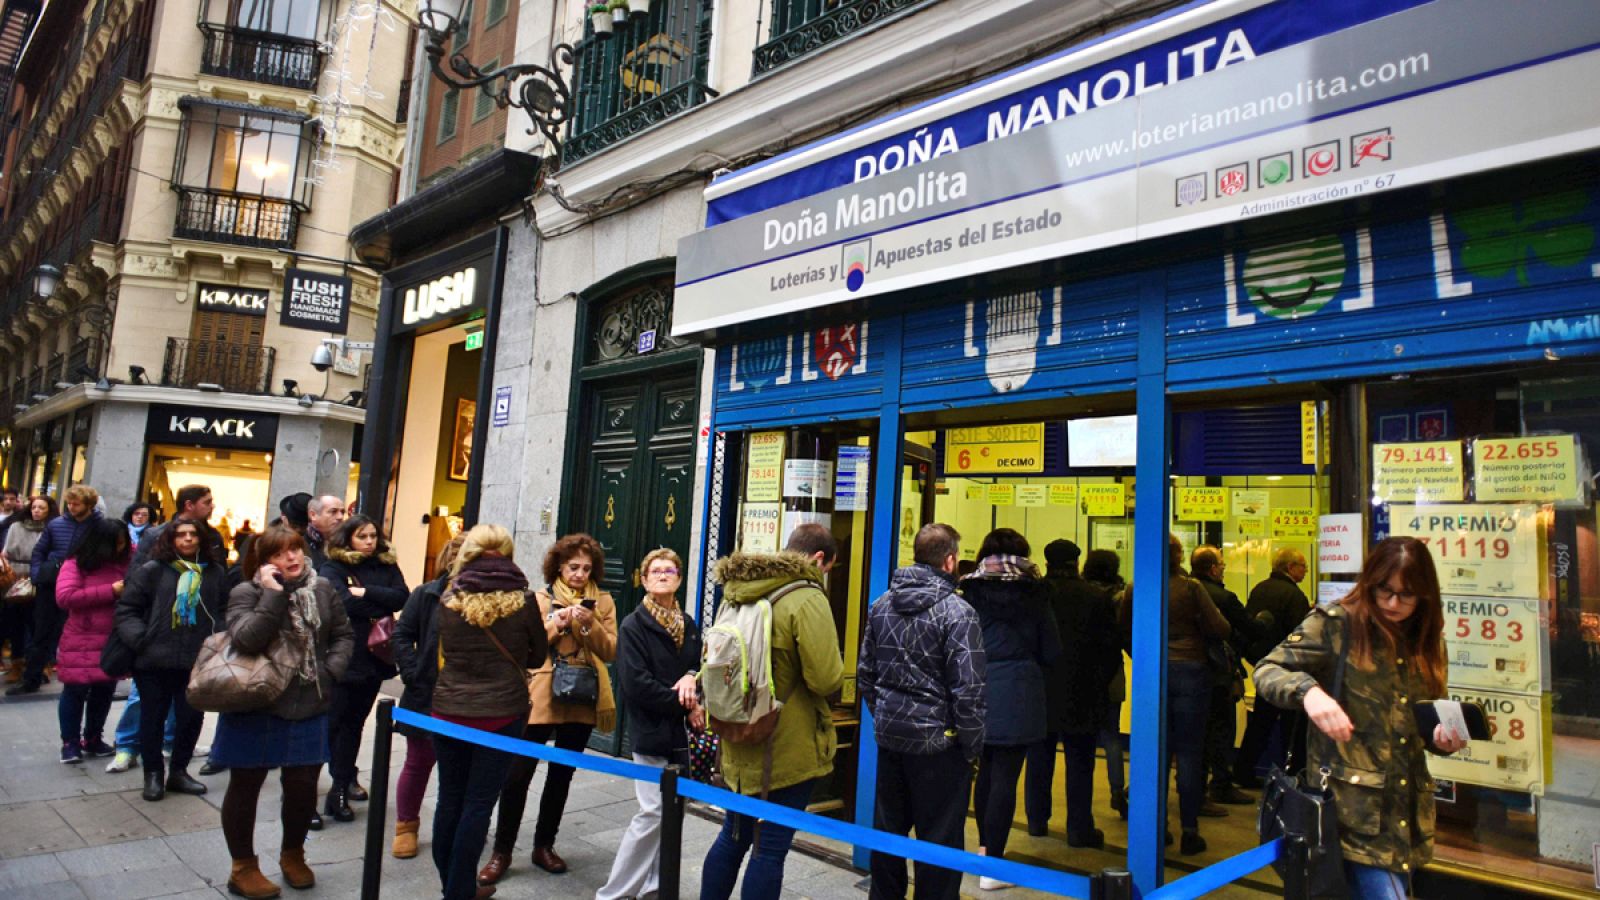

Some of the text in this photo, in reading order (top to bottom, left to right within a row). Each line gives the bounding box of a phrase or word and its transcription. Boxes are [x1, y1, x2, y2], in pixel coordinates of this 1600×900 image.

[854, 28, 1256, 183] DOÑA MANOLITA
[1065, 52, 1430, 169] www.loteriamanolita.com
[1240, 186, 1349, 217] Administración
[1375, 173, 1396, 189] 67
[763, 170, 968, 250] Doña Manolita
[770, 208, 1063, 292] Loterías y Apuestas del Estado
[292, 277, 344, 297] LUSH
[403, 267, 476, 325] LUSH
[200, 289, 266, 309] KRACK
[291, 291, 342, 308] FRESH
[289, 310, 340, 323] COSMETICS
[290, 303, 341, 317] HANDMADE
[169, 415, 255, 438] KRACK
[958, 449, 971, 470] 6
[997, 457, 1034, 468] DECIMO
[1381, 446, 1447, 464] 79.141
[1483, 441, 1559, 461] 22.655
[1482, 462, 1566, 473] Número posterior
[1494, 475, 1520, 484] gordo
[1523, 473, 1537, 481] del
[1184, 495, 1224, 504] 24258
[744, 521, 775, 534] 71119
[1323, 524, 1348, 533] VENTA
[1429, 515, 1517, 532] PREMIO
[1441, 600, 1509, 617] REMIO
